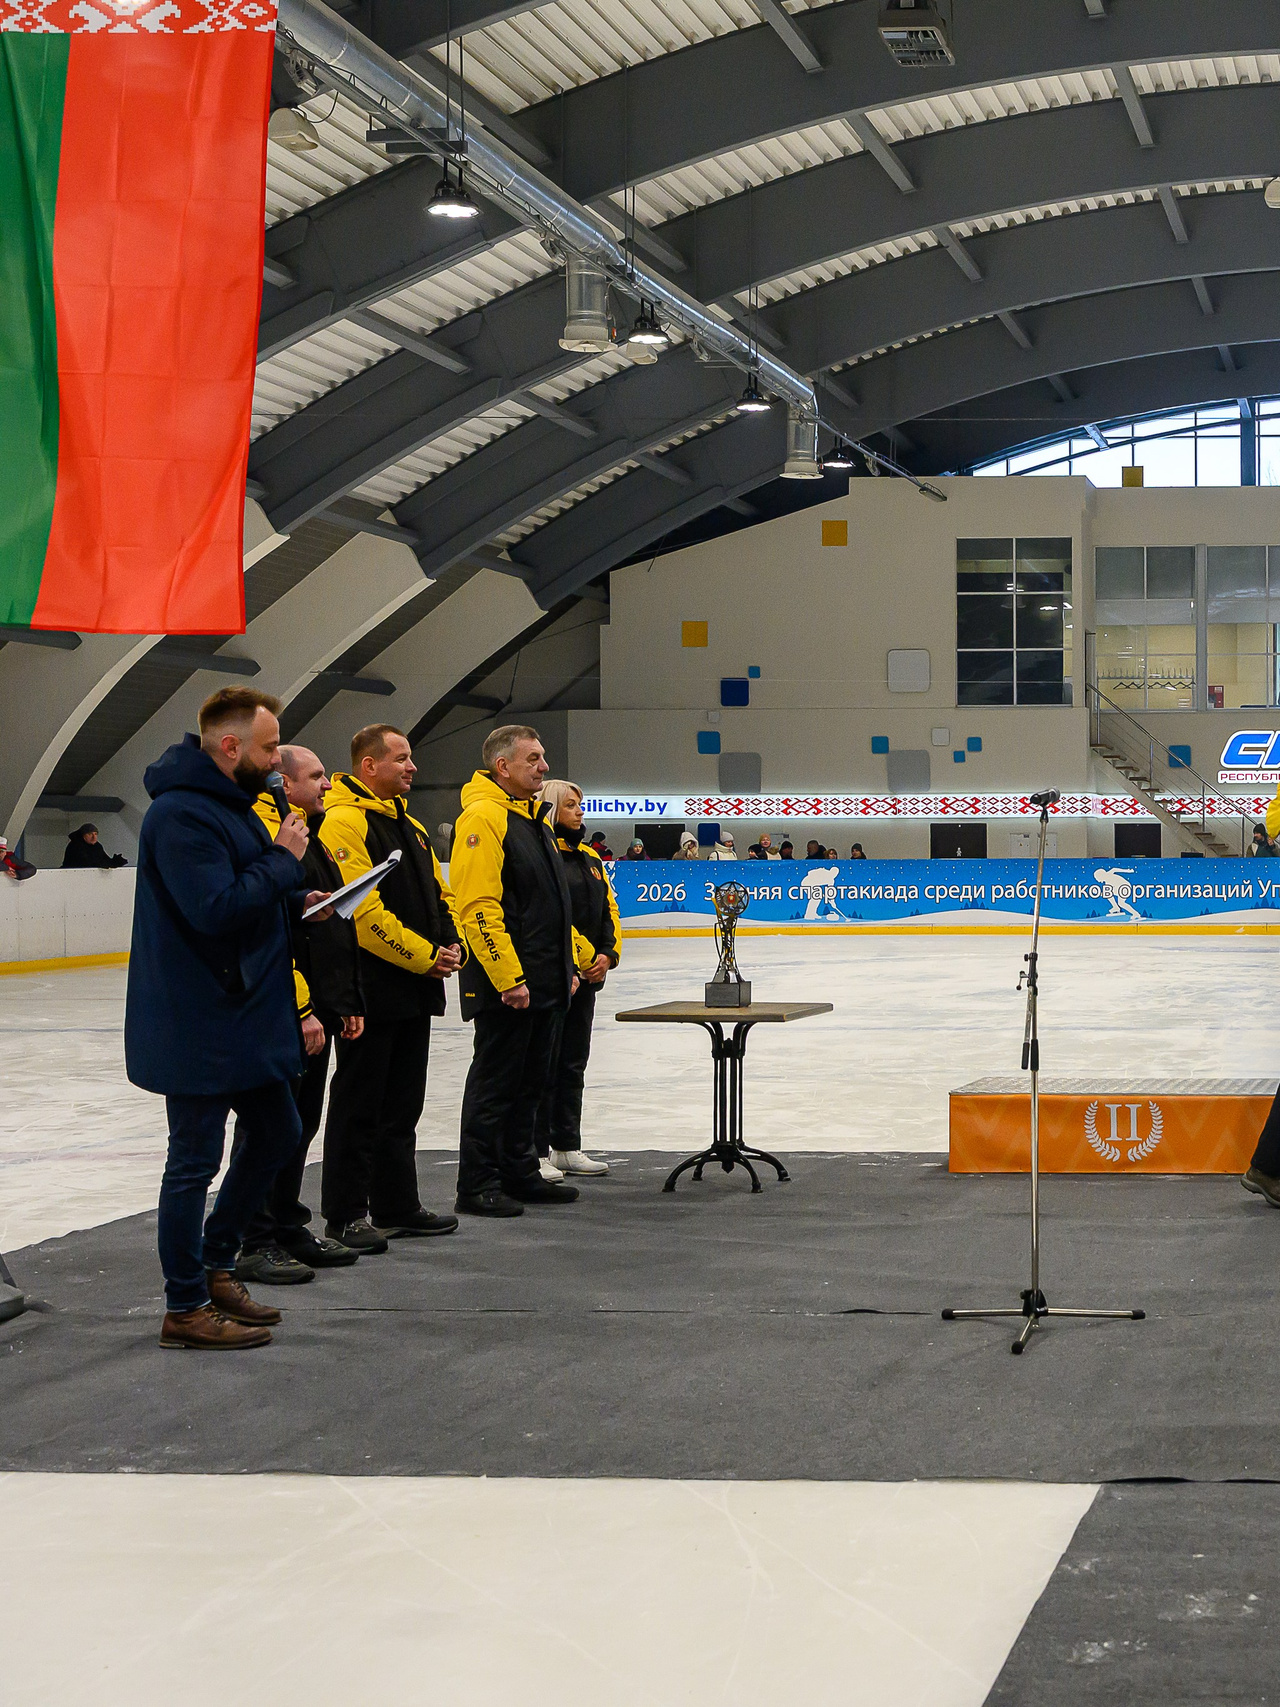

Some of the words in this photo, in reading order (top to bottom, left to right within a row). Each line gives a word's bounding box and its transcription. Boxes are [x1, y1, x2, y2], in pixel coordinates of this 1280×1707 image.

[637, 883, 687, 902] 2026
[704, 882, 782, 901] Зняя
[788, 884, 919, 904] спартакиада
[923, 884, 986, 904] среди
[991, 877, 1113, 904] работников
[1117, 879, 1253, 903] организаций
[370, 923, 415, 961] BELARUS
[475, 911, 501, 962] BELARUS
[1104, 1103, 1143, 1141] II
